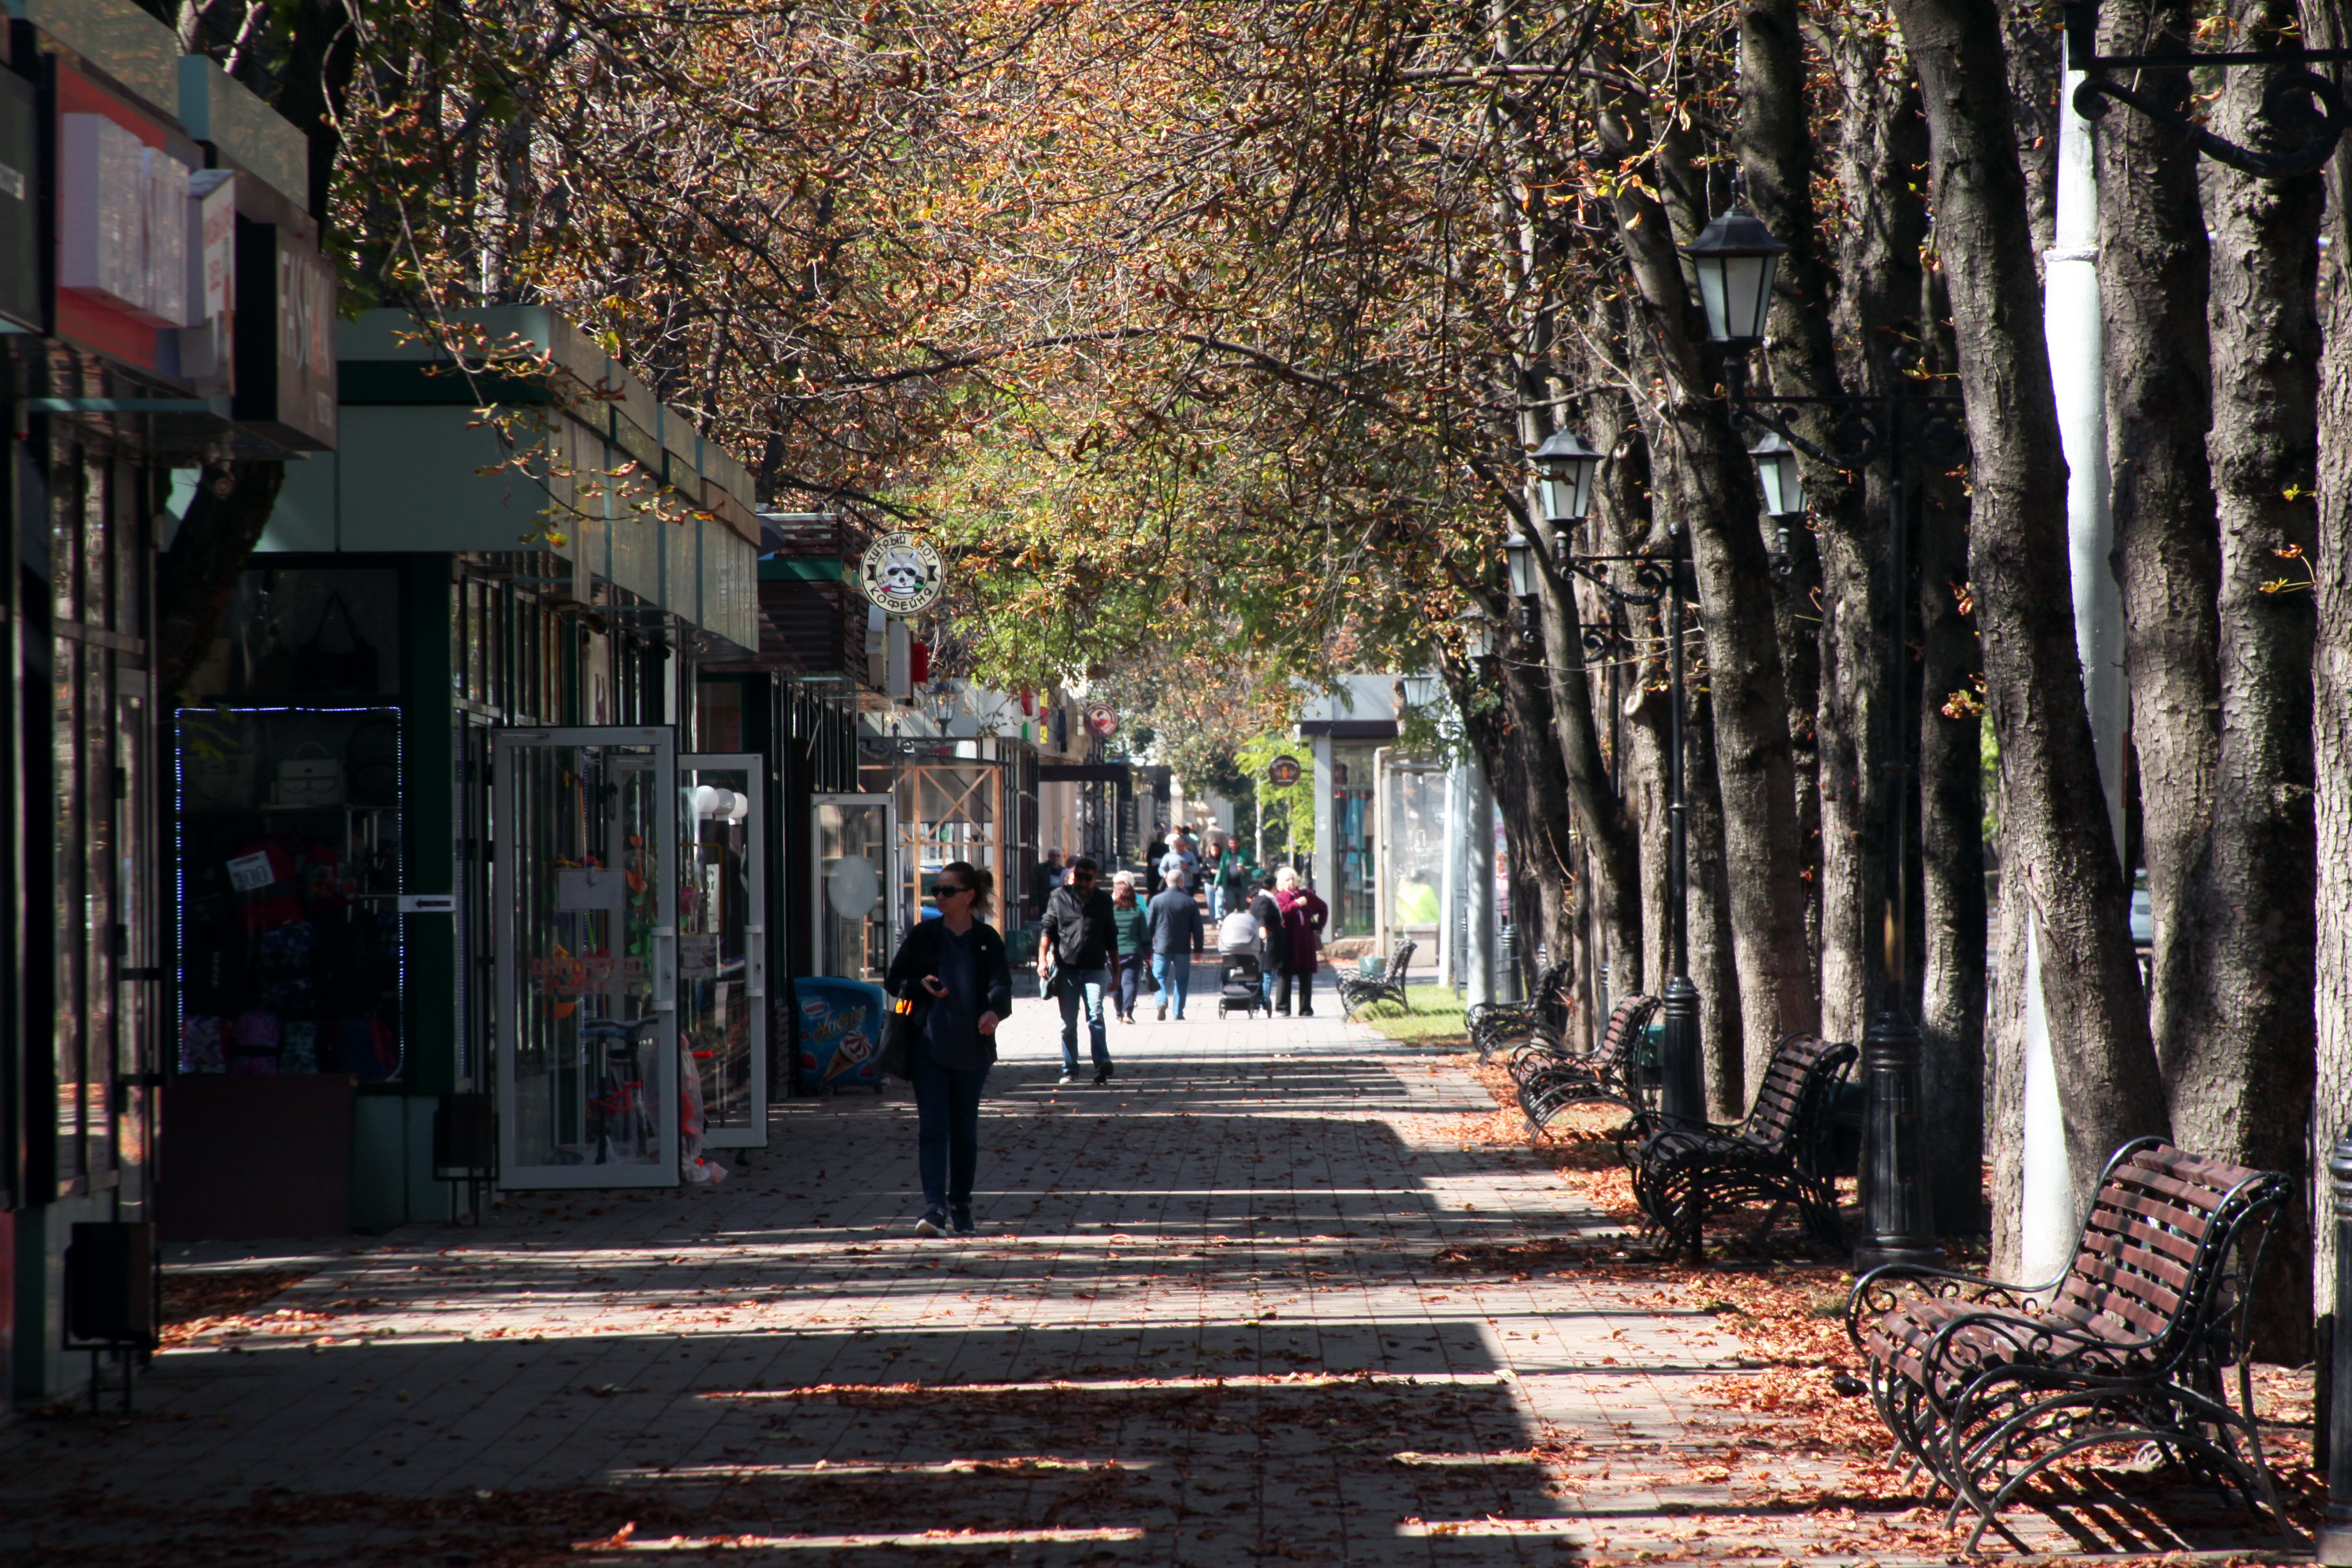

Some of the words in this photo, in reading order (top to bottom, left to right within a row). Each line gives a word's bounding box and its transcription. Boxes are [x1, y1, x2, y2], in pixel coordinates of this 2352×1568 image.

[868, 534, 906, 562] ХИТРЫЙ
[912, 539, 936, 562] НОТ
[870, 587, 933, 611] КОФЕЙНЯ
